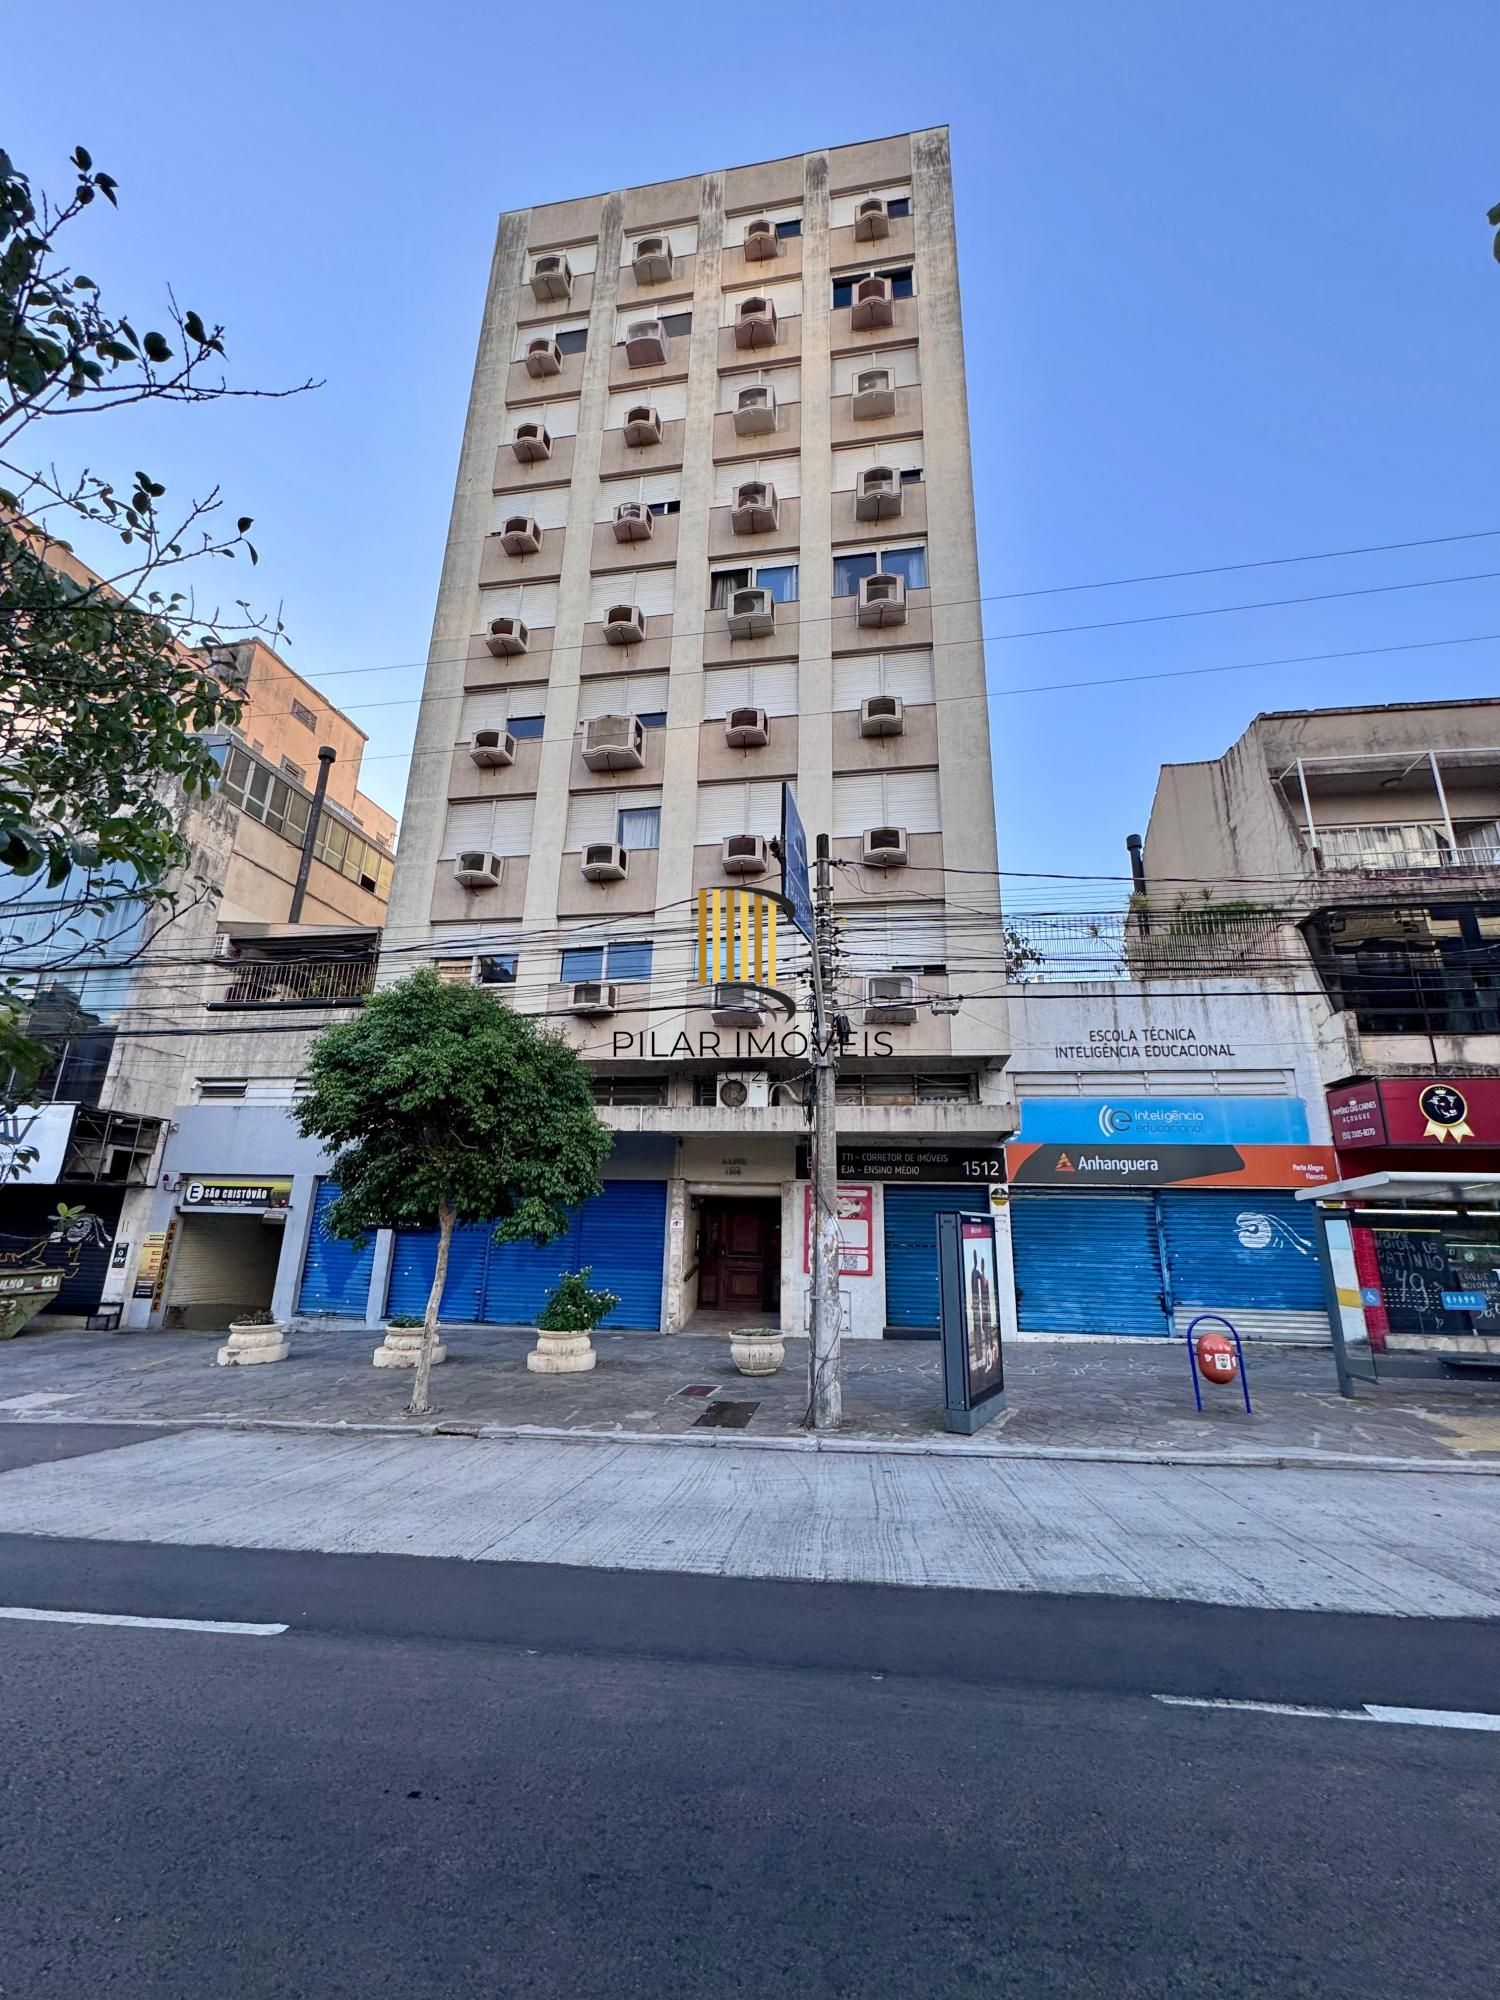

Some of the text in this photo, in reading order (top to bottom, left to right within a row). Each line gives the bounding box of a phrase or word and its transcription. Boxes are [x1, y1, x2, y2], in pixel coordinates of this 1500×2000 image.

[1089, 1027, 1196, 1042] ESCOLA TÉCNICA
[1055, 1043, 1235, 1059] INTELIGÊNCIA EDUCACIONAL
[1134, 1110, 1204, 1124] inteligência
[1136, 1124, 1203, 1133] educacional
[861, 1153, 902, 1162] CORRETOR
[904, 1153, 915, 1162] DE
[917, 1152, 949, 1163] IMÓVEIS
[1078, 1155, 1158, 1174] Anhanguera
[841, 1164, 855, 1174] EJA
[863, 1165, 892, 1175] ENSINO
[894, 1164, 920, 1175] MÉDIO
[962, 1161, 999, 1176] 1512
[204, 1188, 220, 1198] SÃO
[222, 1188, 267, 1199] CRISTÓVÃO
